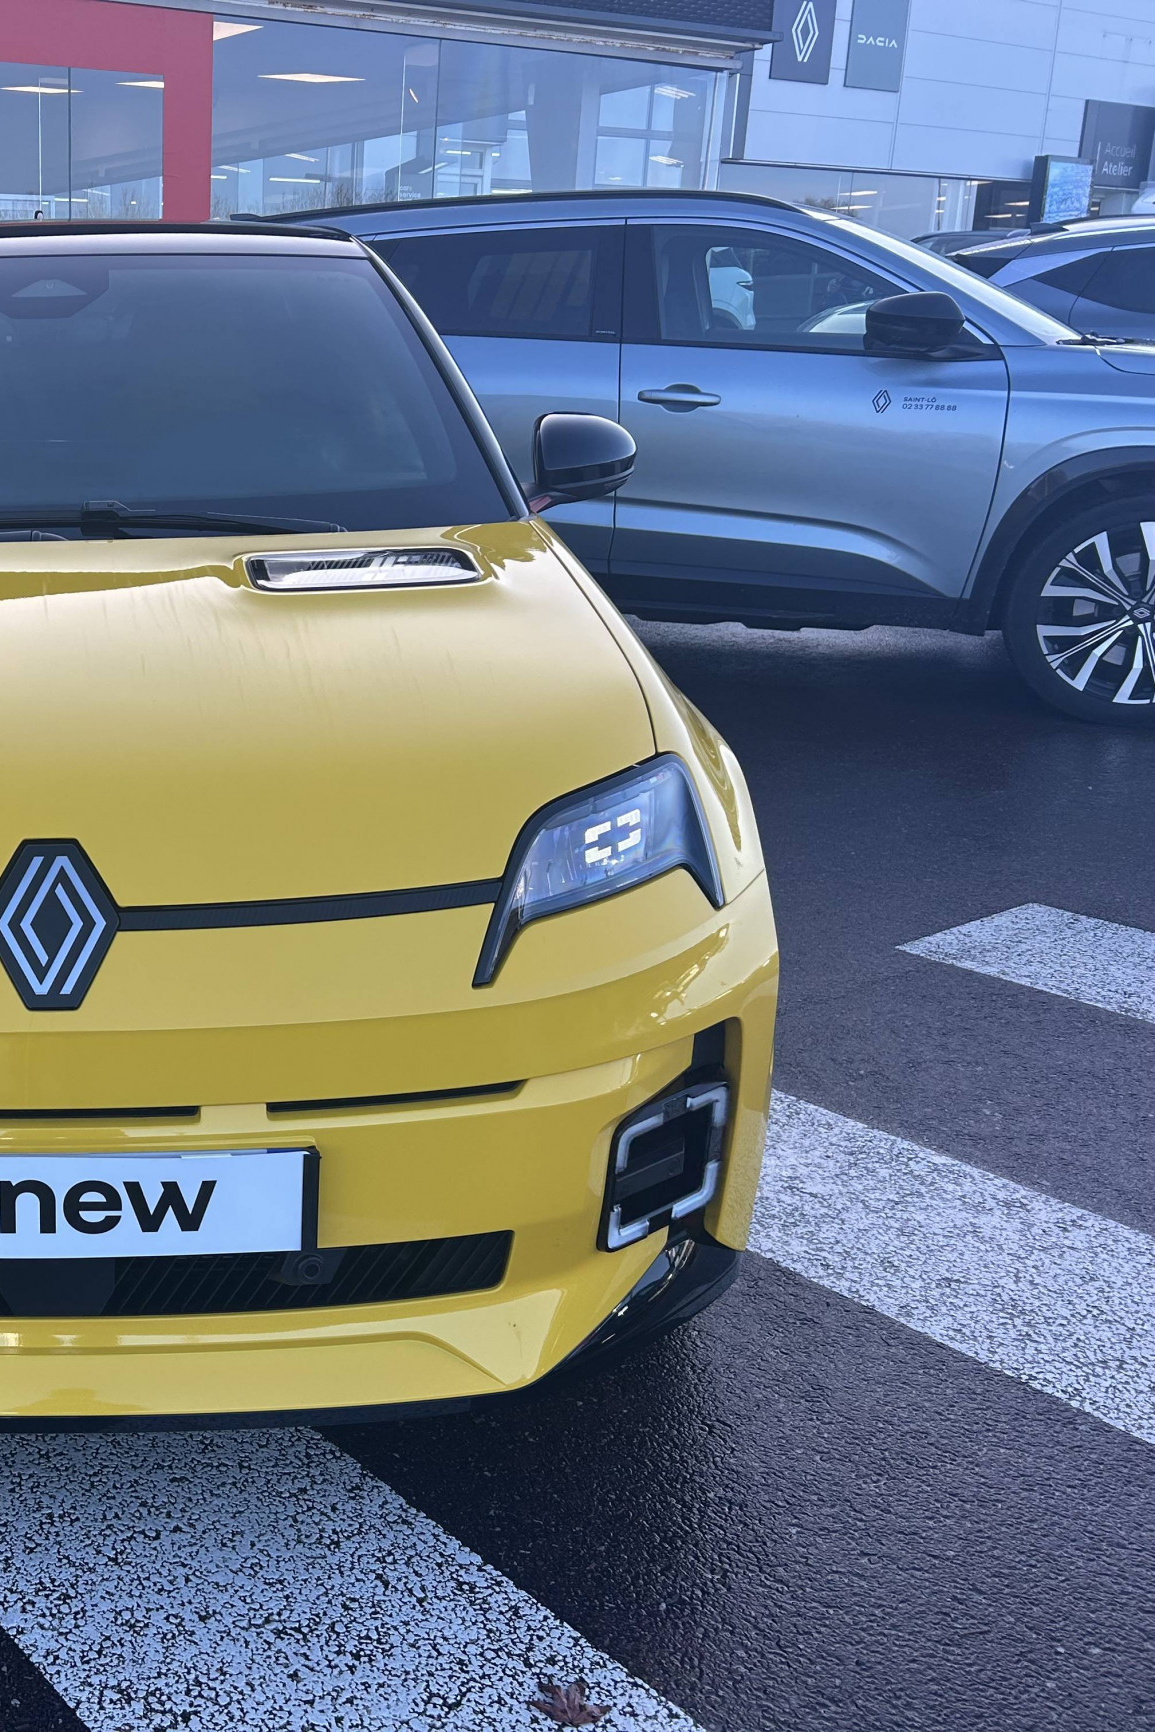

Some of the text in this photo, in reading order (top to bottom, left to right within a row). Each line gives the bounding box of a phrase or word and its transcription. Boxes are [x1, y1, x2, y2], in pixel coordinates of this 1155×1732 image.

[857, 34, 898, 49] DACIA
[1105, 142, 1137, 158] Accueil
[1101, 160, 1133, 177] Atelier
